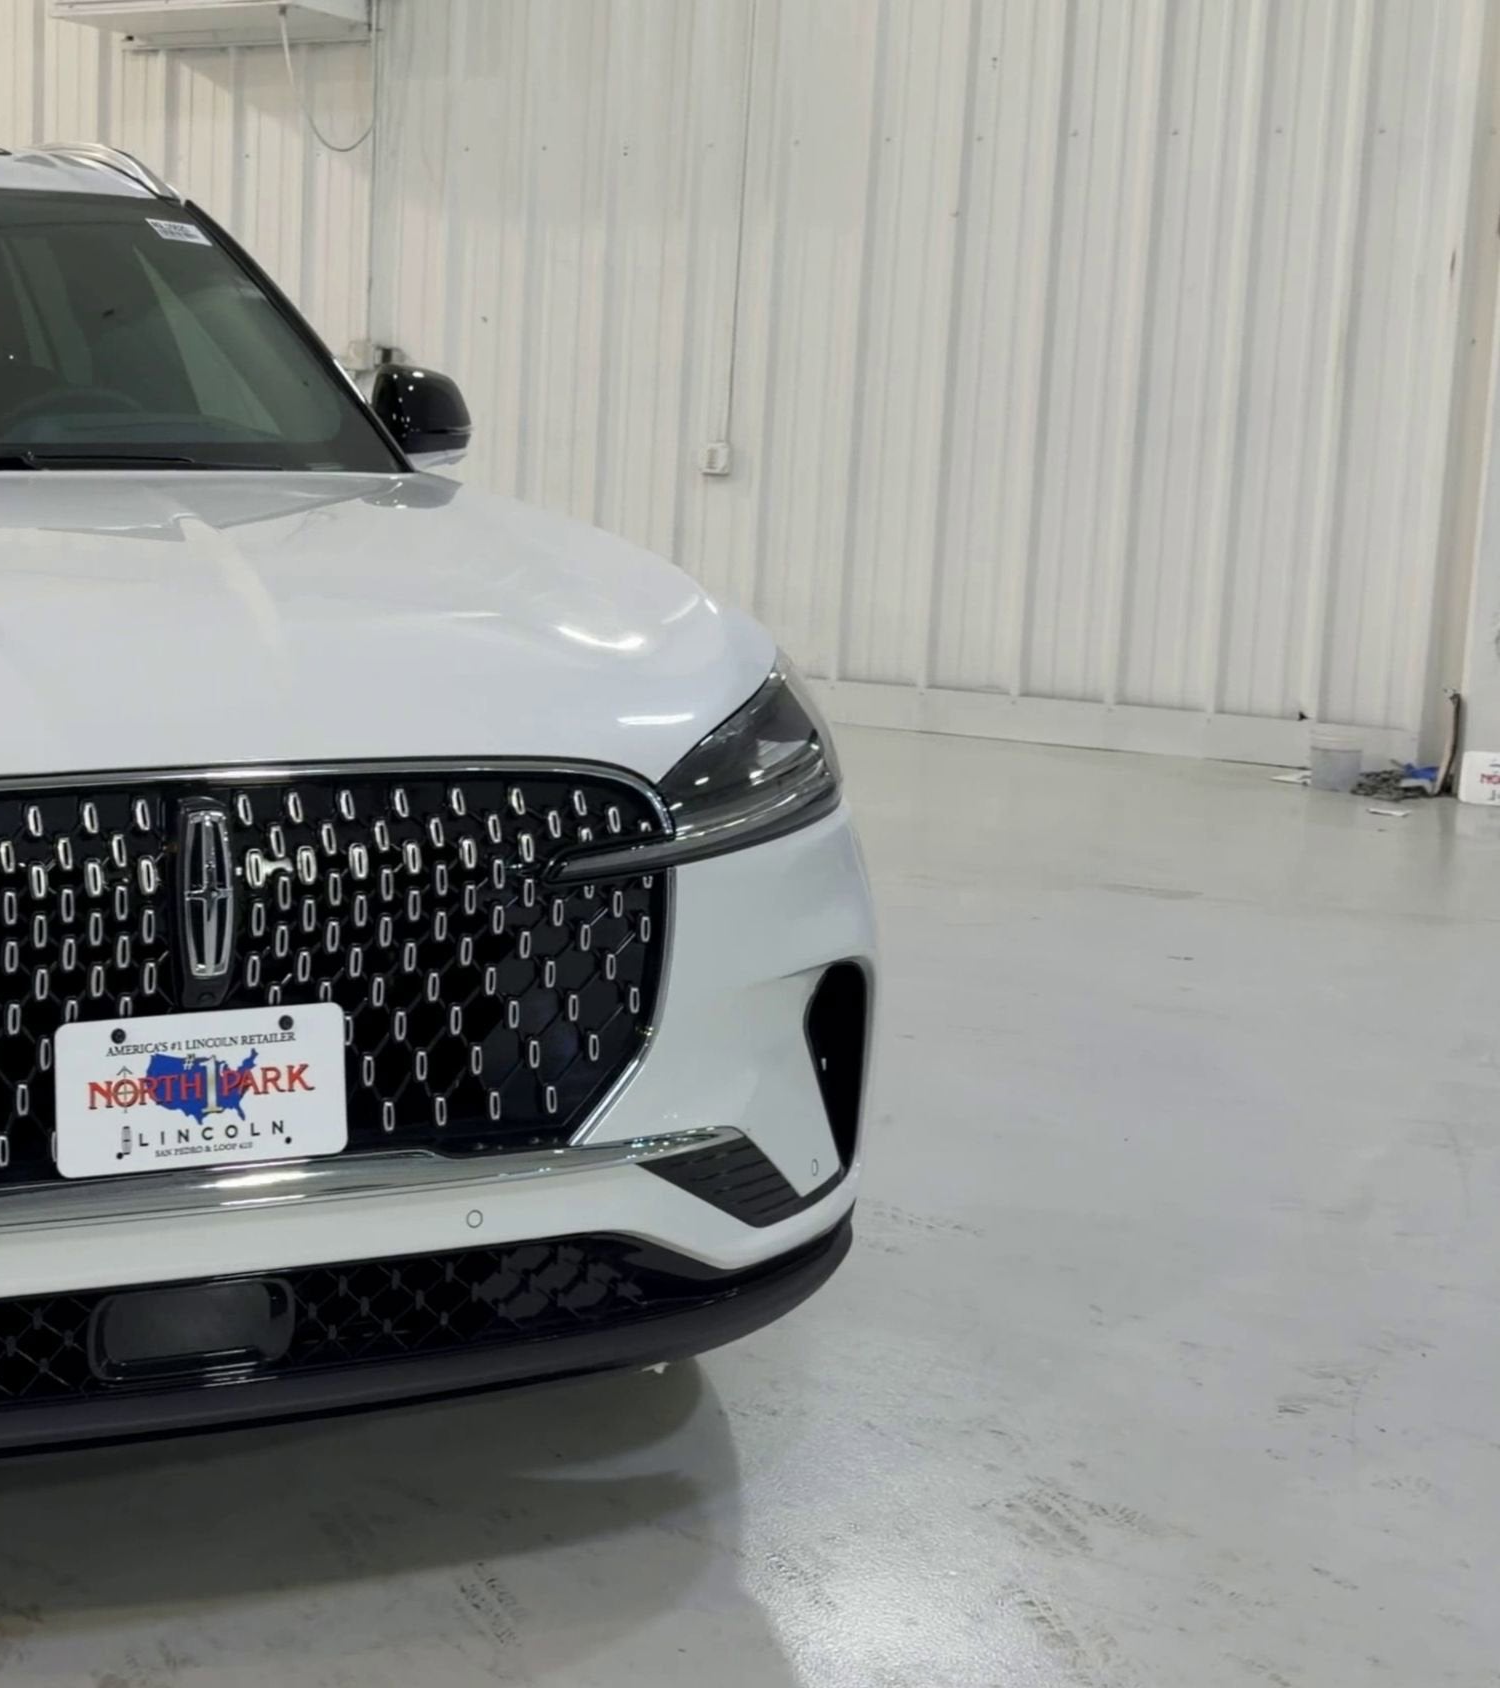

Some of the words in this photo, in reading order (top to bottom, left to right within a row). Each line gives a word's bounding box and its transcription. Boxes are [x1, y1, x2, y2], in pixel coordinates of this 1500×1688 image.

[106, 1042, 168, 1057] AMERICA'S
[170, 1040, 183, 1052] #1
[185, 1036, 239, 1051] LINCOLN
[240, 1031, 296, 1046] RETAILER
[88, 1072, 203, 1109] NORTH
[223, 1063, 314, 1096] PARK
[139, 1120, 284, 1147] LINCOLN
